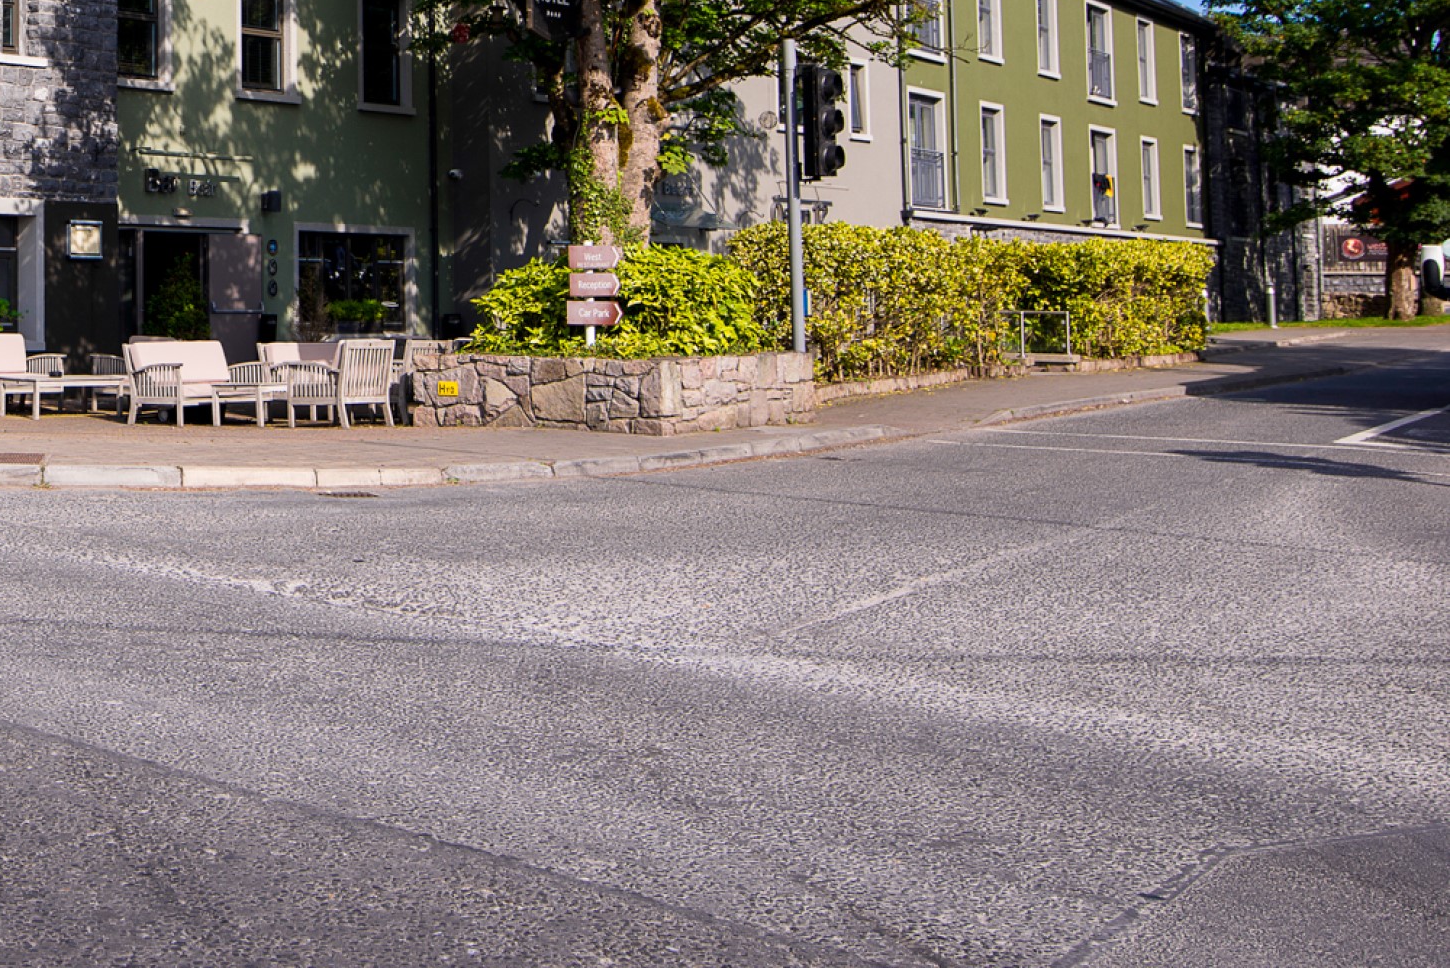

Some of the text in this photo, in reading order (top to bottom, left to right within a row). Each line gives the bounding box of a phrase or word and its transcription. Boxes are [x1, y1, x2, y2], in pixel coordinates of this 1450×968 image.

[583, 253, 602, 262] West
[578, 280, 613, 291] Reception
[578, 307, 610, 318] Car Park
